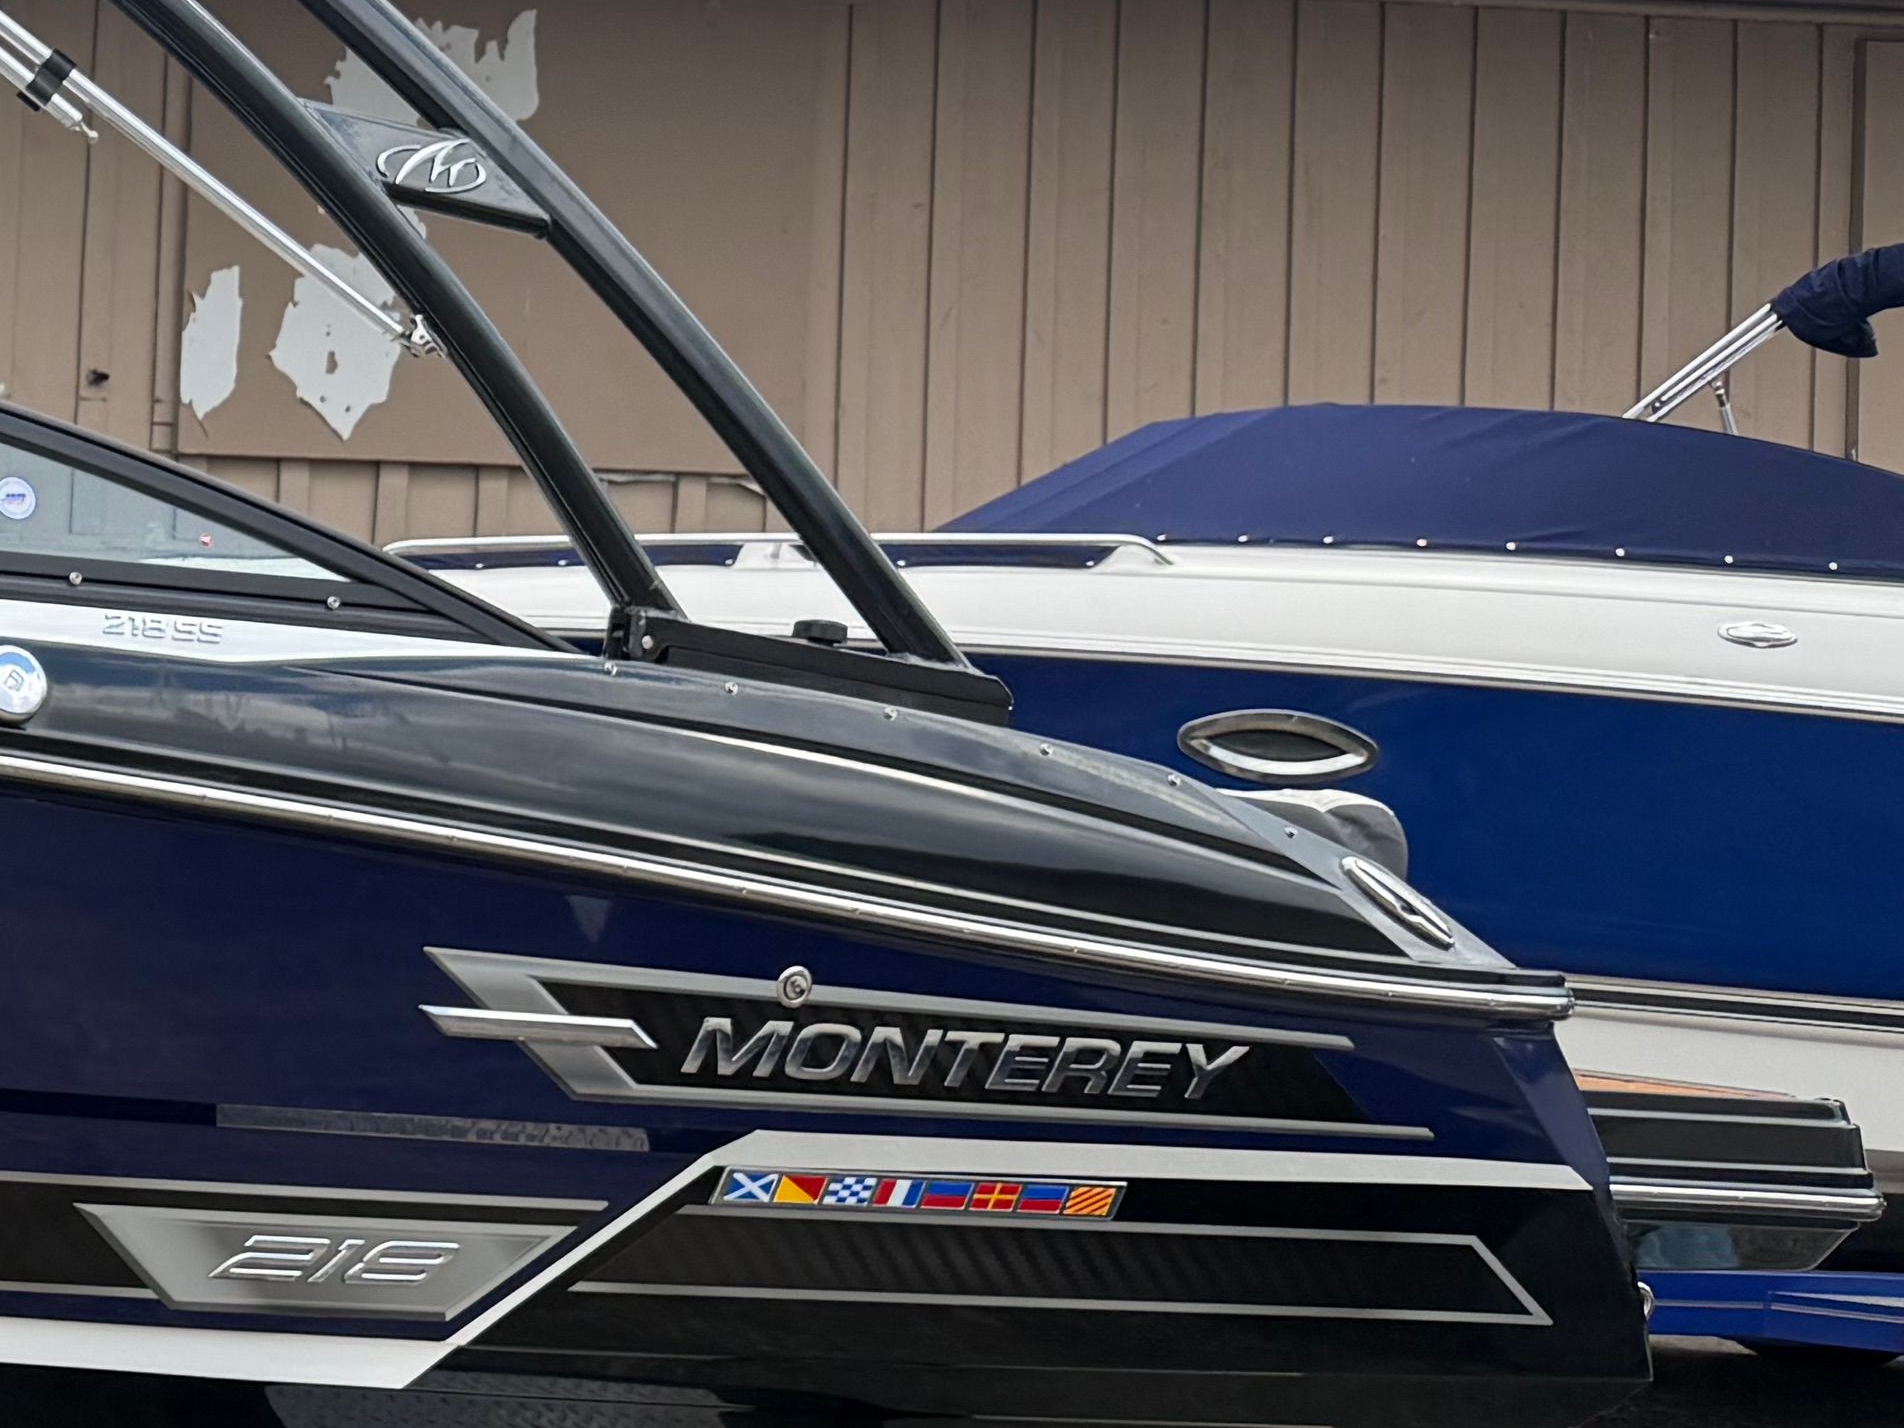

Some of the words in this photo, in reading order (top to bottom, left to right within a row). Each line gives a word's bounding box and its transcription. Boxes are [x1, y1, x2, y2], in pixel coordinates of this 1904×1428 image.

[102, 613, 166, 640] 218
[171, 621, 224, 645] SS
[680, 1016, 1250, 1099] MONTEREY
[208, 1234, 461, 1286] 218
